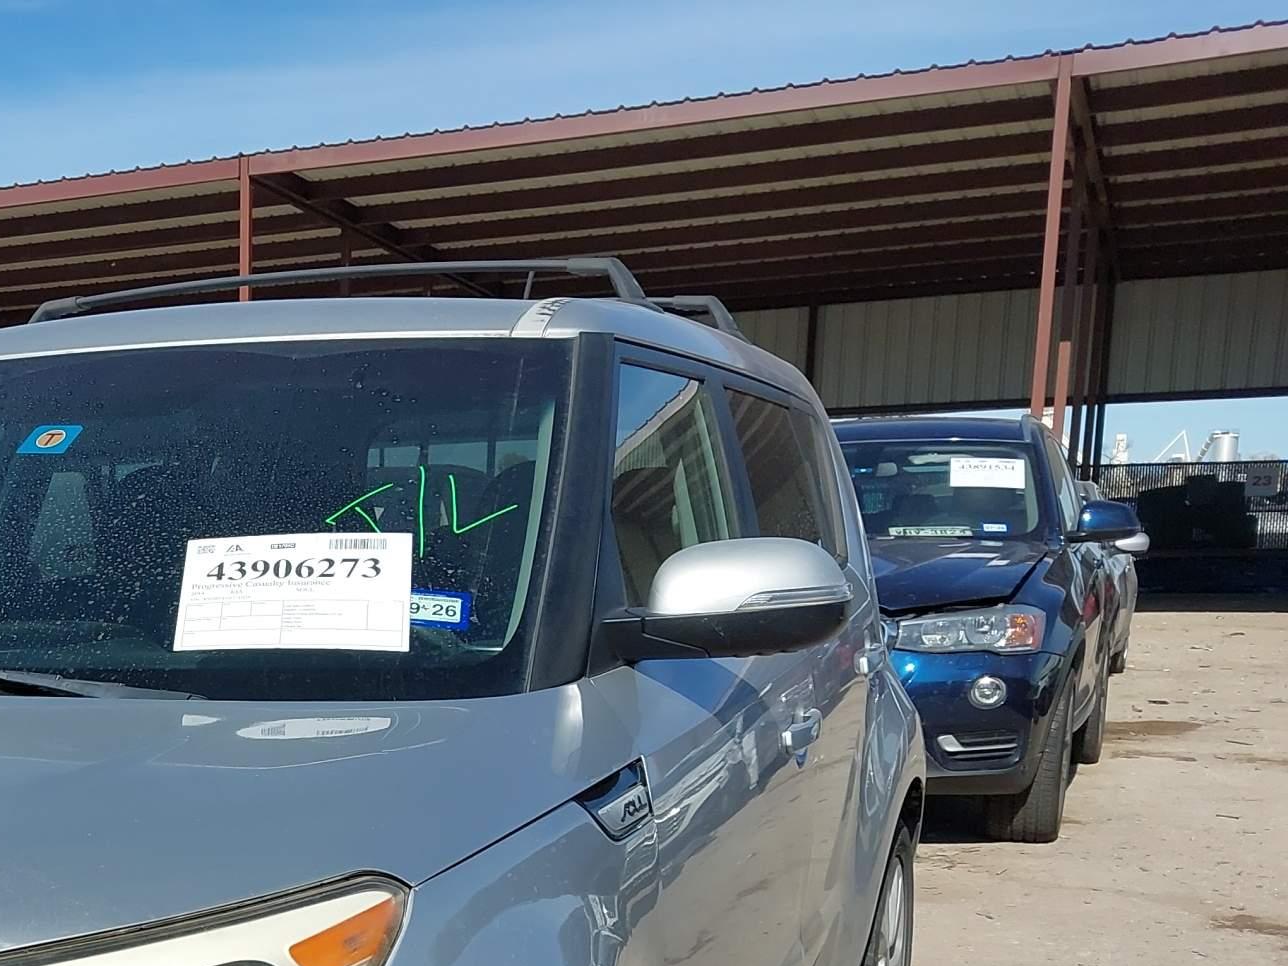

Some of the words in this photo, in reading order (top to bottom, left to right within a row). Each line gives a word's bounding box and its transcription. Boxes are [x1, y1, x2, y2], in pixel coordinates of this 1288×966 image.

[44, 432, 63, 446] T
[206, 557, 382, 581] 43906273
[192, 582, 243, 591] Progressive
[245, 580, 285, 589] Casualty
[287, 579, 331, 587] Insurance
